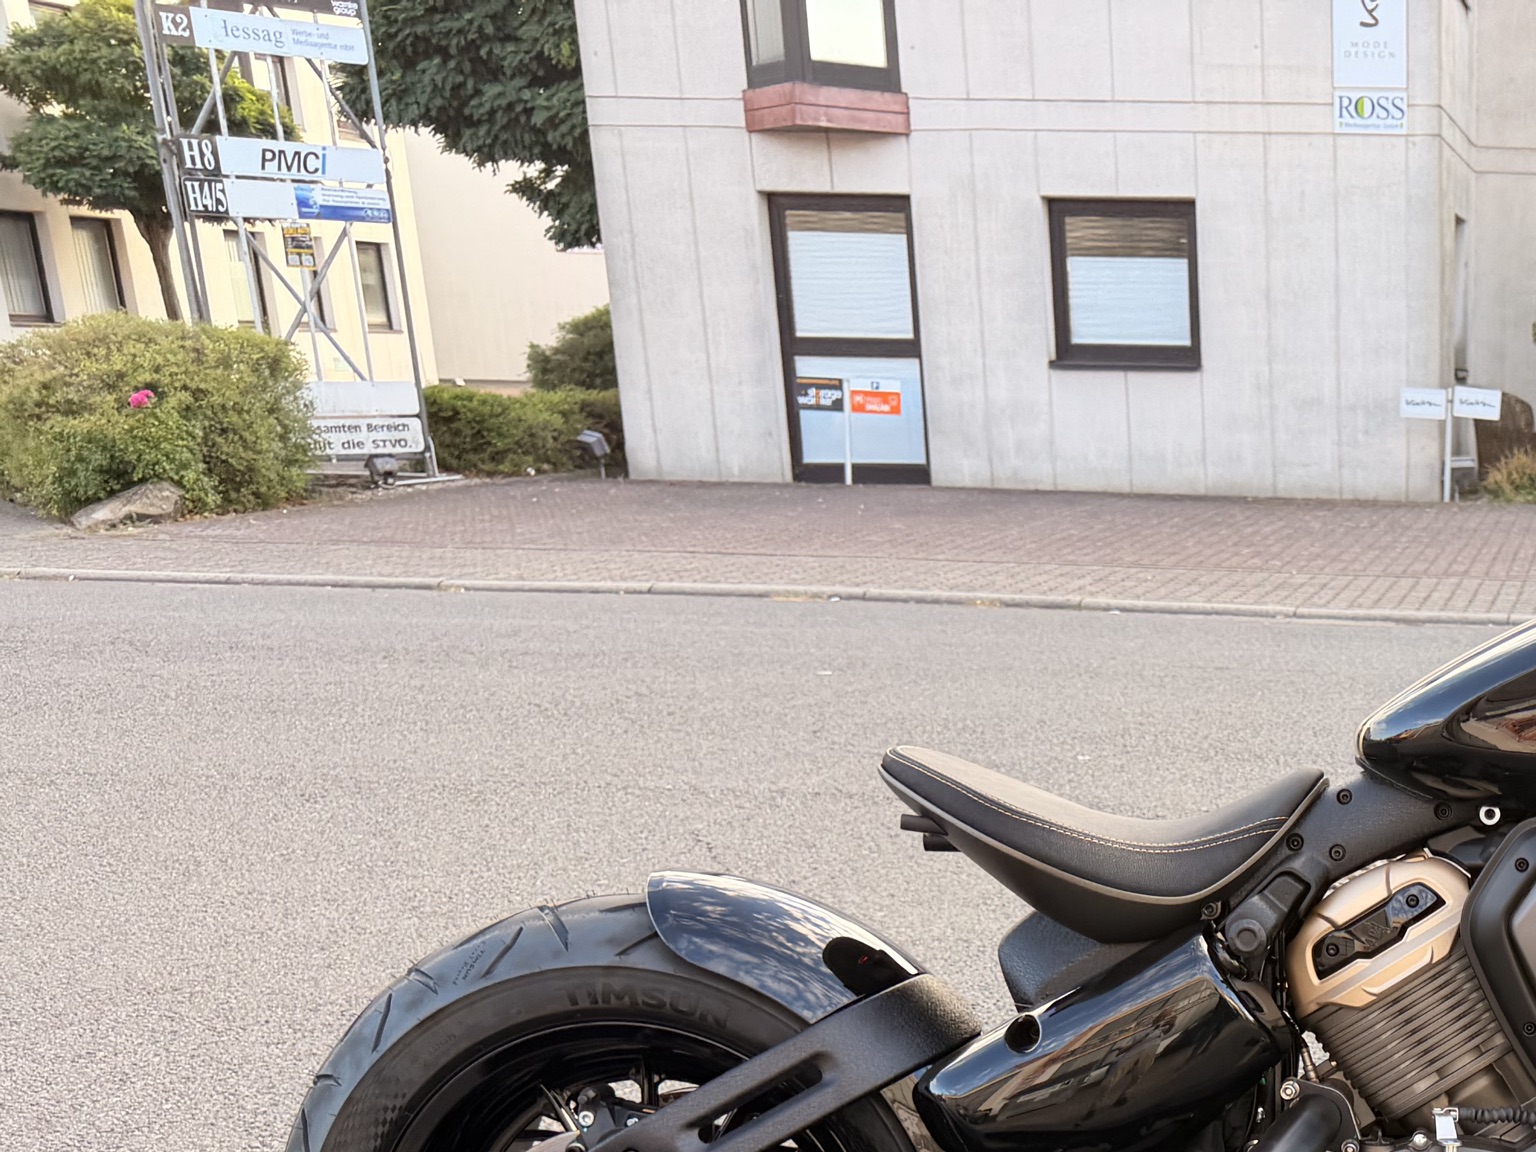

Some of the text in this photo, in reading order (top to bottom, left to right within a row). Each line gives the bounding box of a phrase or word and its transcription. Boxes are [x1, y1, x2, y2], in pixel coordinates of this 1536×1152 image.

[159, 11, 190, 38] K2
[1343, 49, 1396, 59] DESIGN
[1350, 40, 1388, 49] MODE
[1338, 95, 1405, 120] ROSS
[180, 138, 215, 171] H8
[184, 180, 228, 213] H4/5
[366, 421, 410, 433] Bereich
[341, 439, 365, 450] die
[563, 982, 733, 1033] TIMSUN
